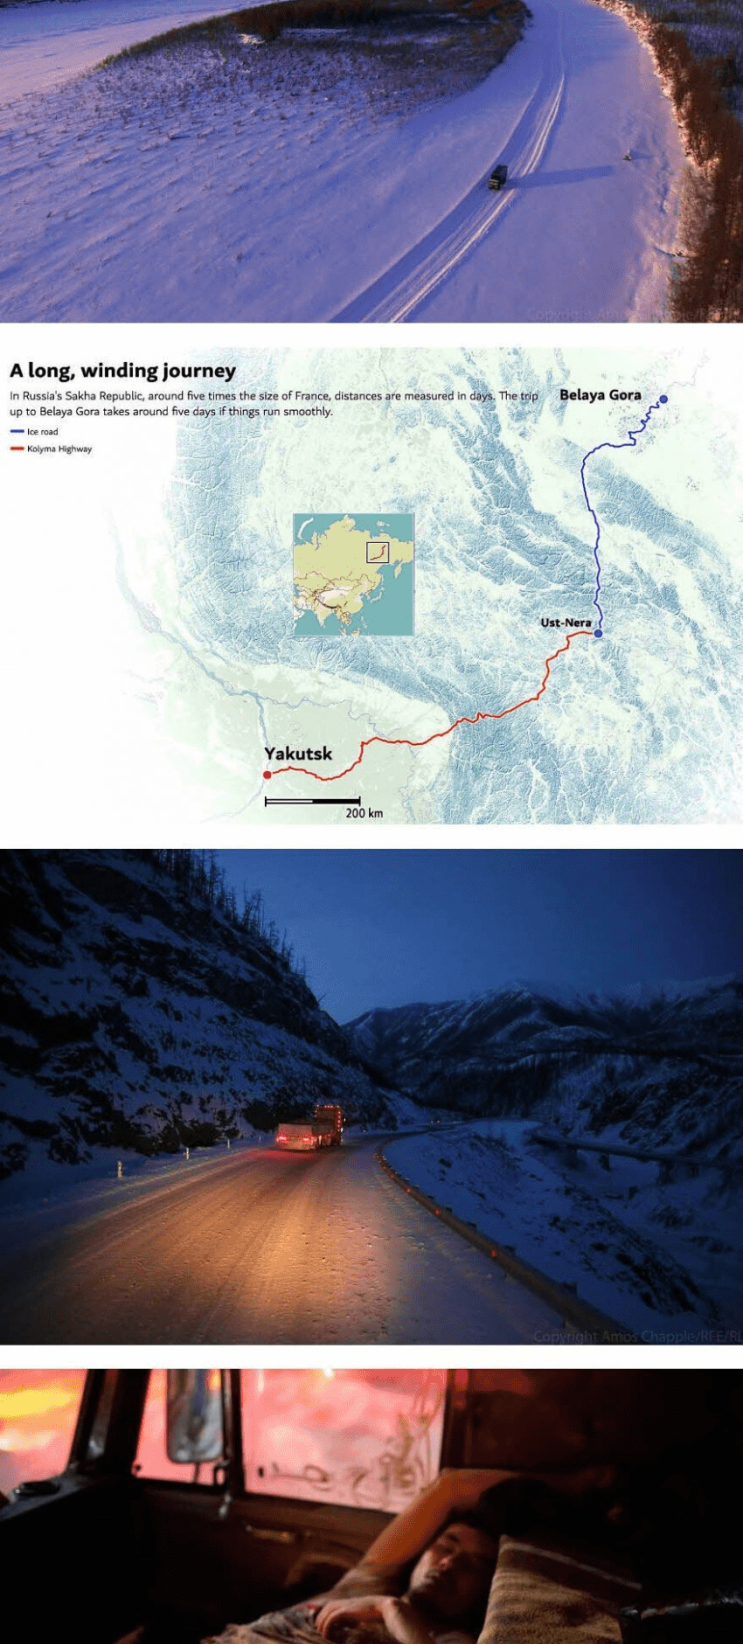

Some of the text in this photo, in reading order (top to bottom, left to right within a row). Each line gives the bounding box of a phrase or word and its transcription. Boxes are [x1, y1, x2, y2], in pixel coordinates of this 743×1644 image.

[9, 361, 237, 383] A long, winding journey
[10, 390, 539, 404] In Russia's Sakha Republic, around five times the size of France, distances are measured in days. The trip
[560, 388, 642, 404] Belaya Gora
[10, 405, 333, 419] up to Belaya Gora takes around five days if things run smoothly.
[27, 427, 59, 436] Ice road
[27, 444, 93, 456] Kolyma Highway
[540, 617, 592, 629] Ust-Nera
[264, 745, 333, 761] Yakutsk
[346, 807, 383, 819] 200 km
